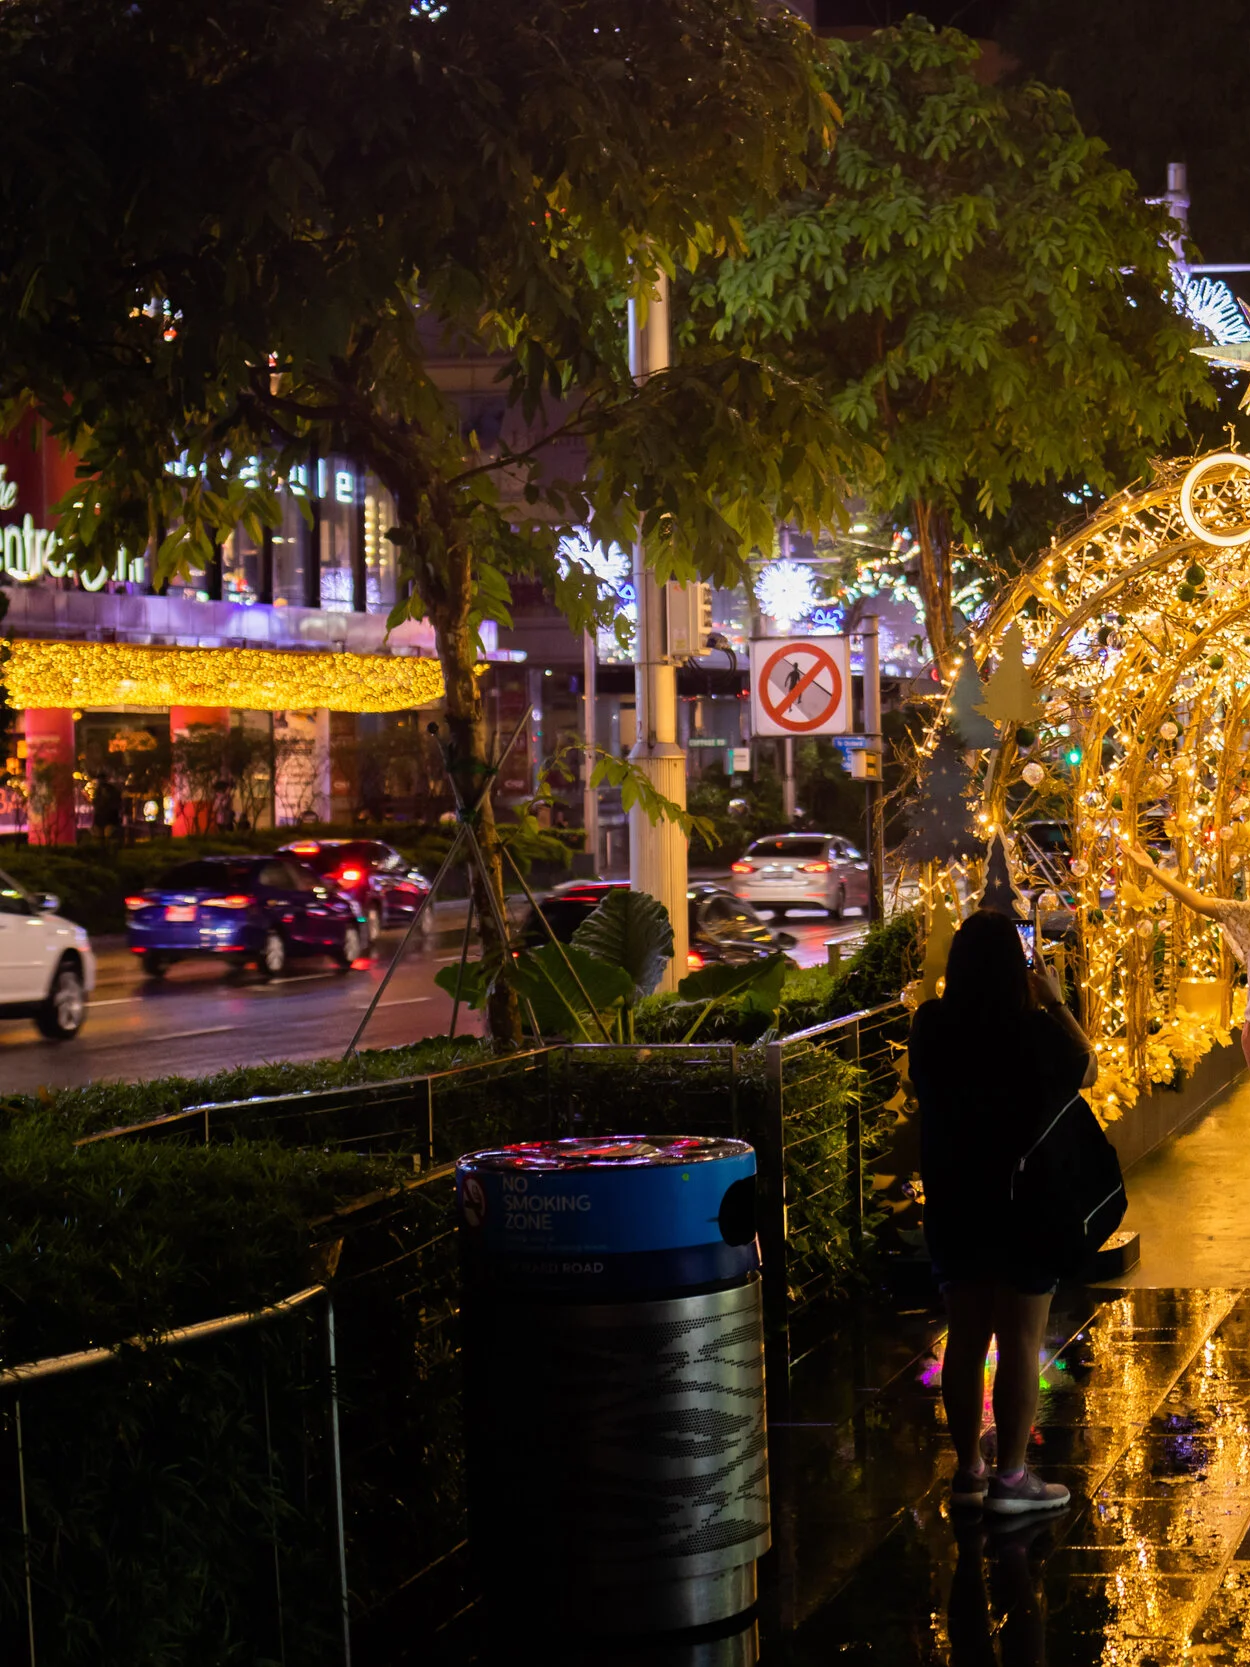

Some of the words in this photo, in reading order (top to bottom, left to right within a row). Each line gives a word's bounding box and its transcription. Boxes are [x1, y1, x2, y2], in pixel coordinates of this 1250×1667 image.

[502, 1176, 528, 1192] NO
[502, 1194, 592, 1212] SMOKING
[504, 1213, 553, 1230] ZONE
[562, 1261, 604, 1274] ROAD
